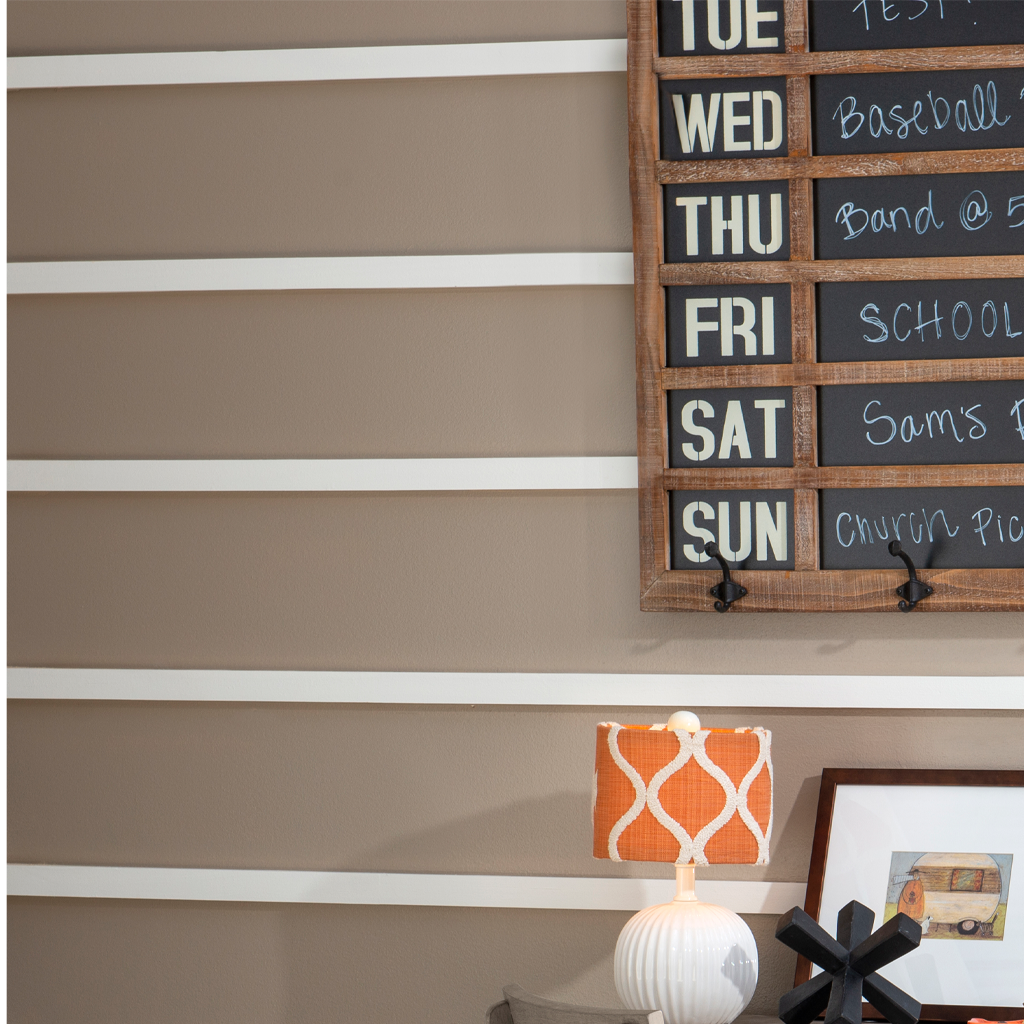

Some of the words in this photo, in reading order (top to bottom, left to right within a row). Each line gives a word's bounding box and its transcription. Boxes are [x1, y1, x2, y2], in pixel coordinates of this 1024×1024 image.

[673, 0, 778, 50] TUE
[673, 91, 782, 153] WED
[833, 81, 1011, 139] Baseball
[676, 194, 782, 255] THU
[835, 189, 944, 240] Band
[686, 297, 774, 357] FRI
[860, 299, 1022, 343] SCHOOL
[682, 400, 785, 460] SAT
[863, 400, 987, 445] Sam's
[683, 502, 787, 562] SUN
